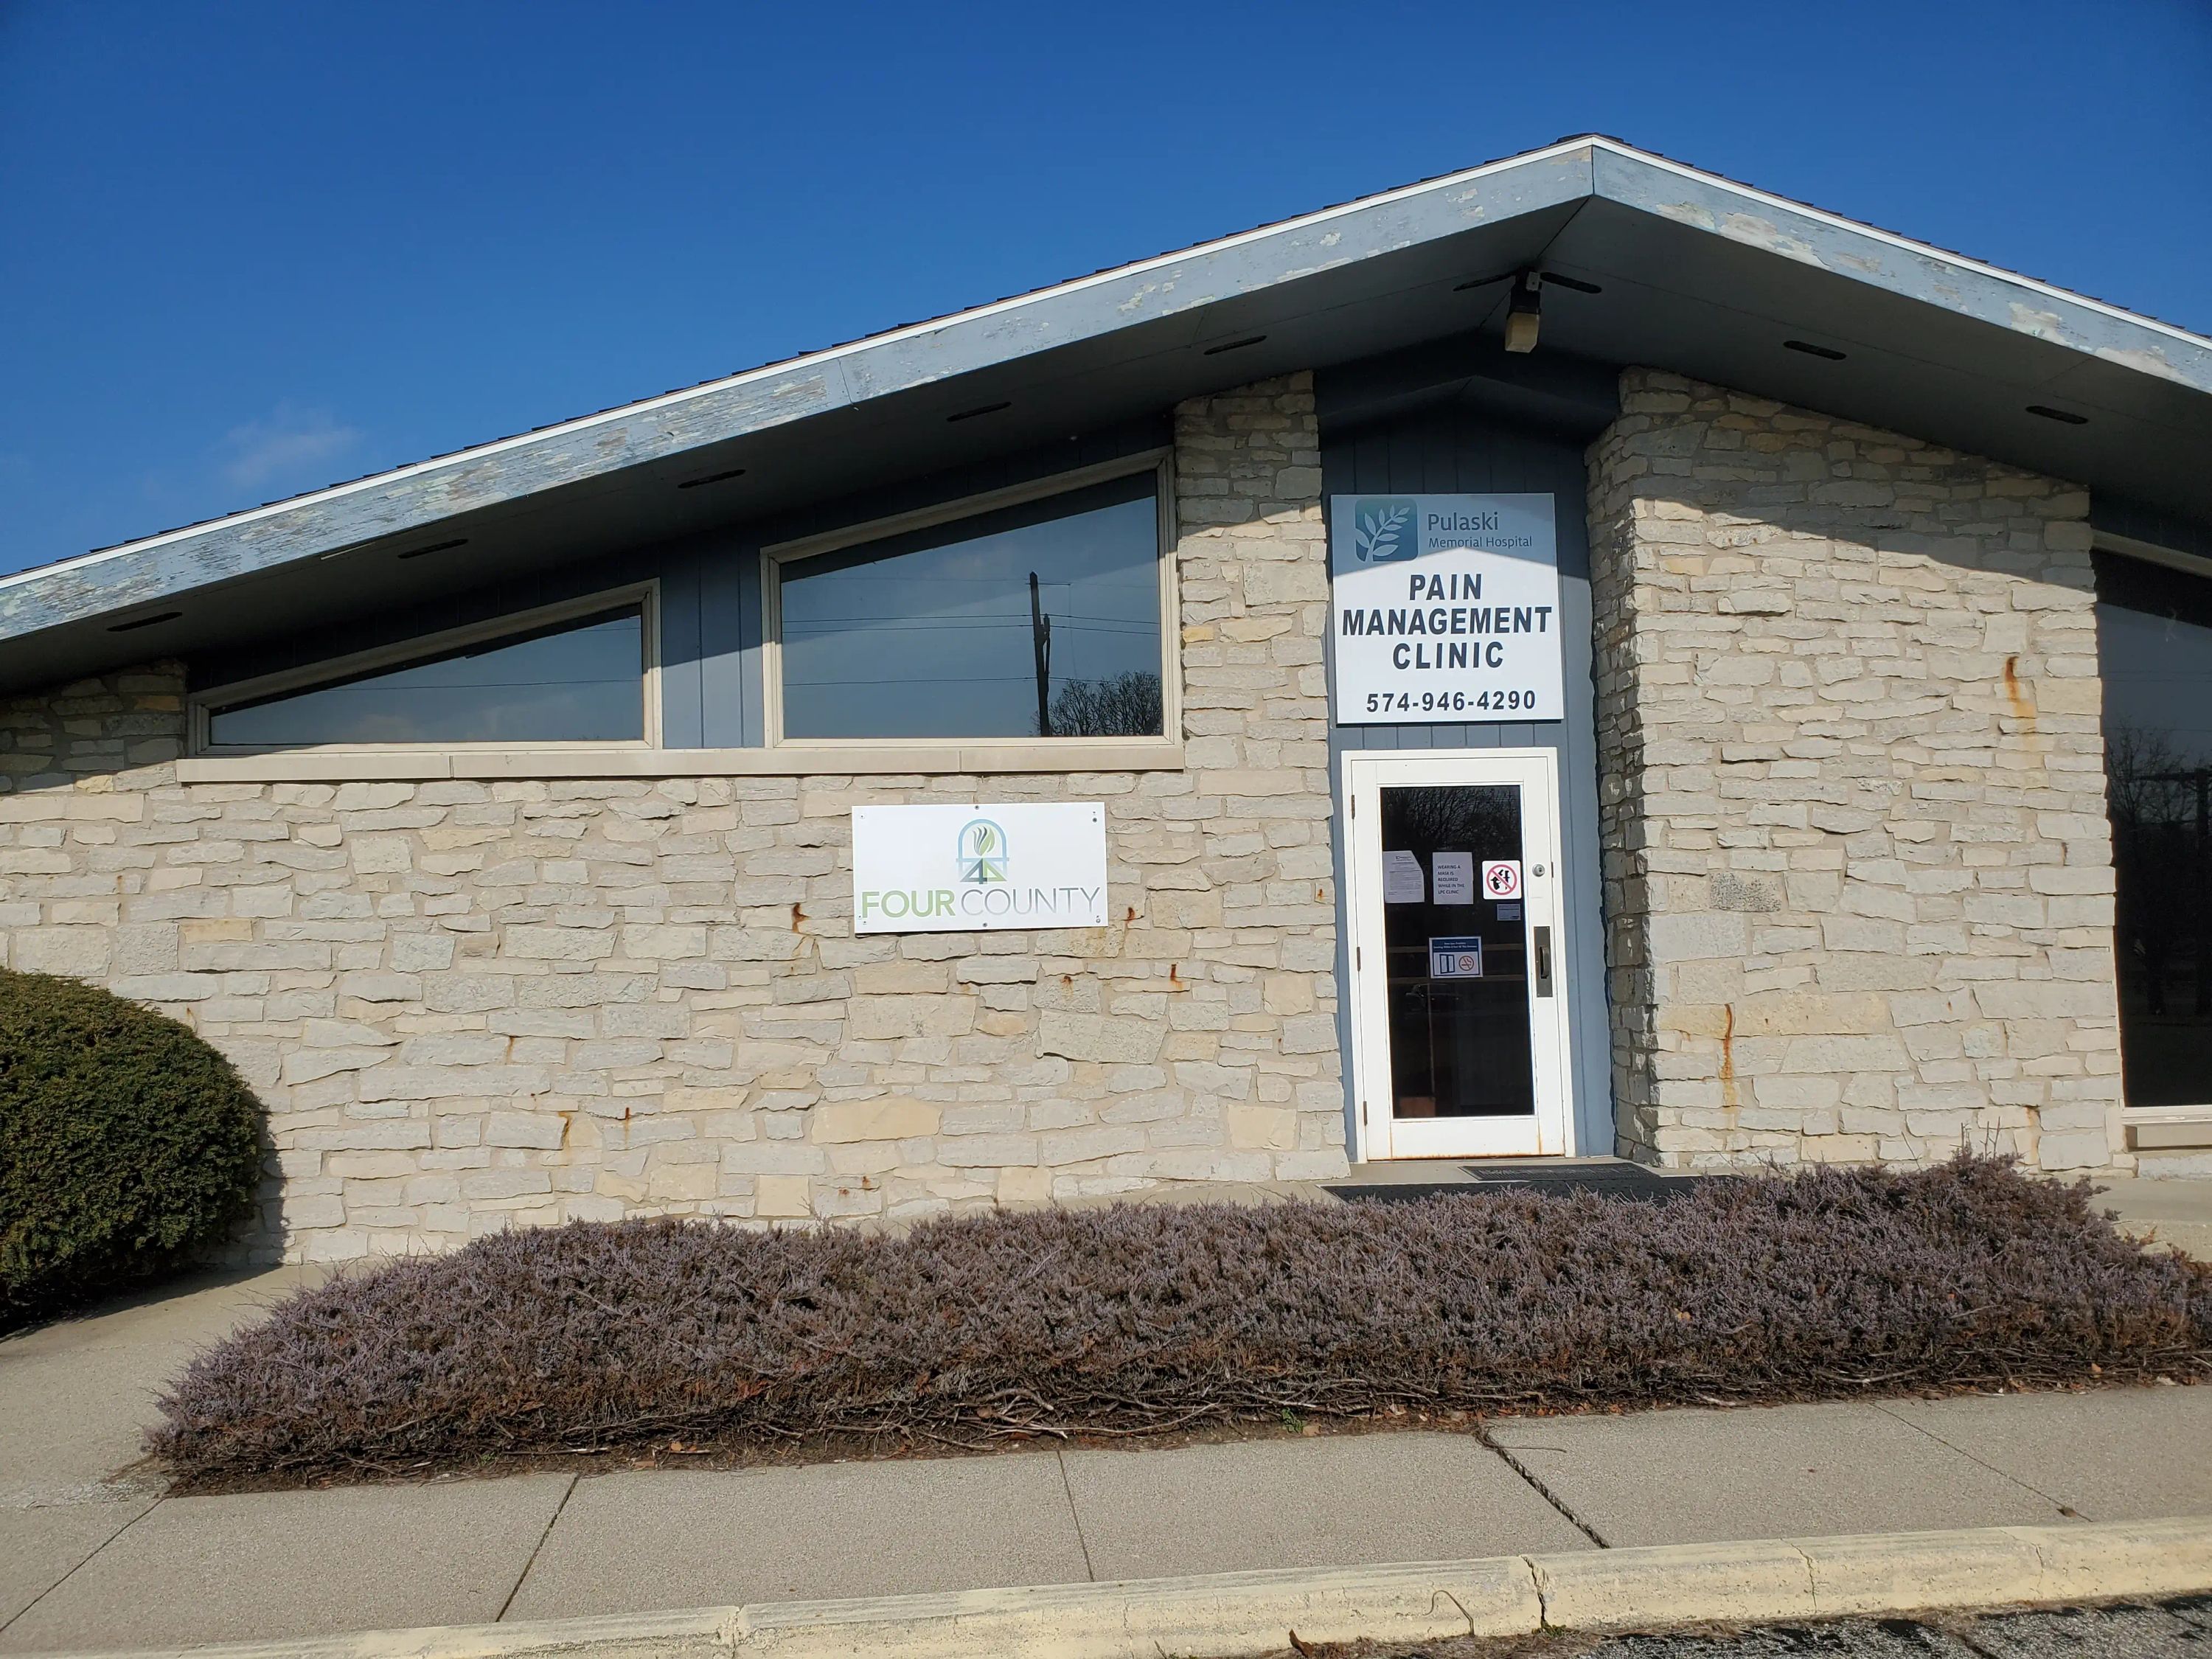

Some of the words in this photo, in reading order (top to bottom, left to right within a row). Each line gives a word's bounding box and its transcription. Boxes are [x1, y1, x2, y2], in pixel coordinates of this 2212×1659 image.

[1427, 512, 1498, 531] Pulaski
[1428, 537, 1482, 548] Memorial
[1486, 535, 1532, 549] Hospital
[1409, 574, 1482, 601] PAIN
[1342, 606, 1552, 636] MANAGEMENT
[1393, 641, 1503, 669] CLINIC
[1366, 690, 1536, 712] 574-946-4290
[861, 890, 956, 918] FOUR
[961, 887, 1101, 916] COUNTY
